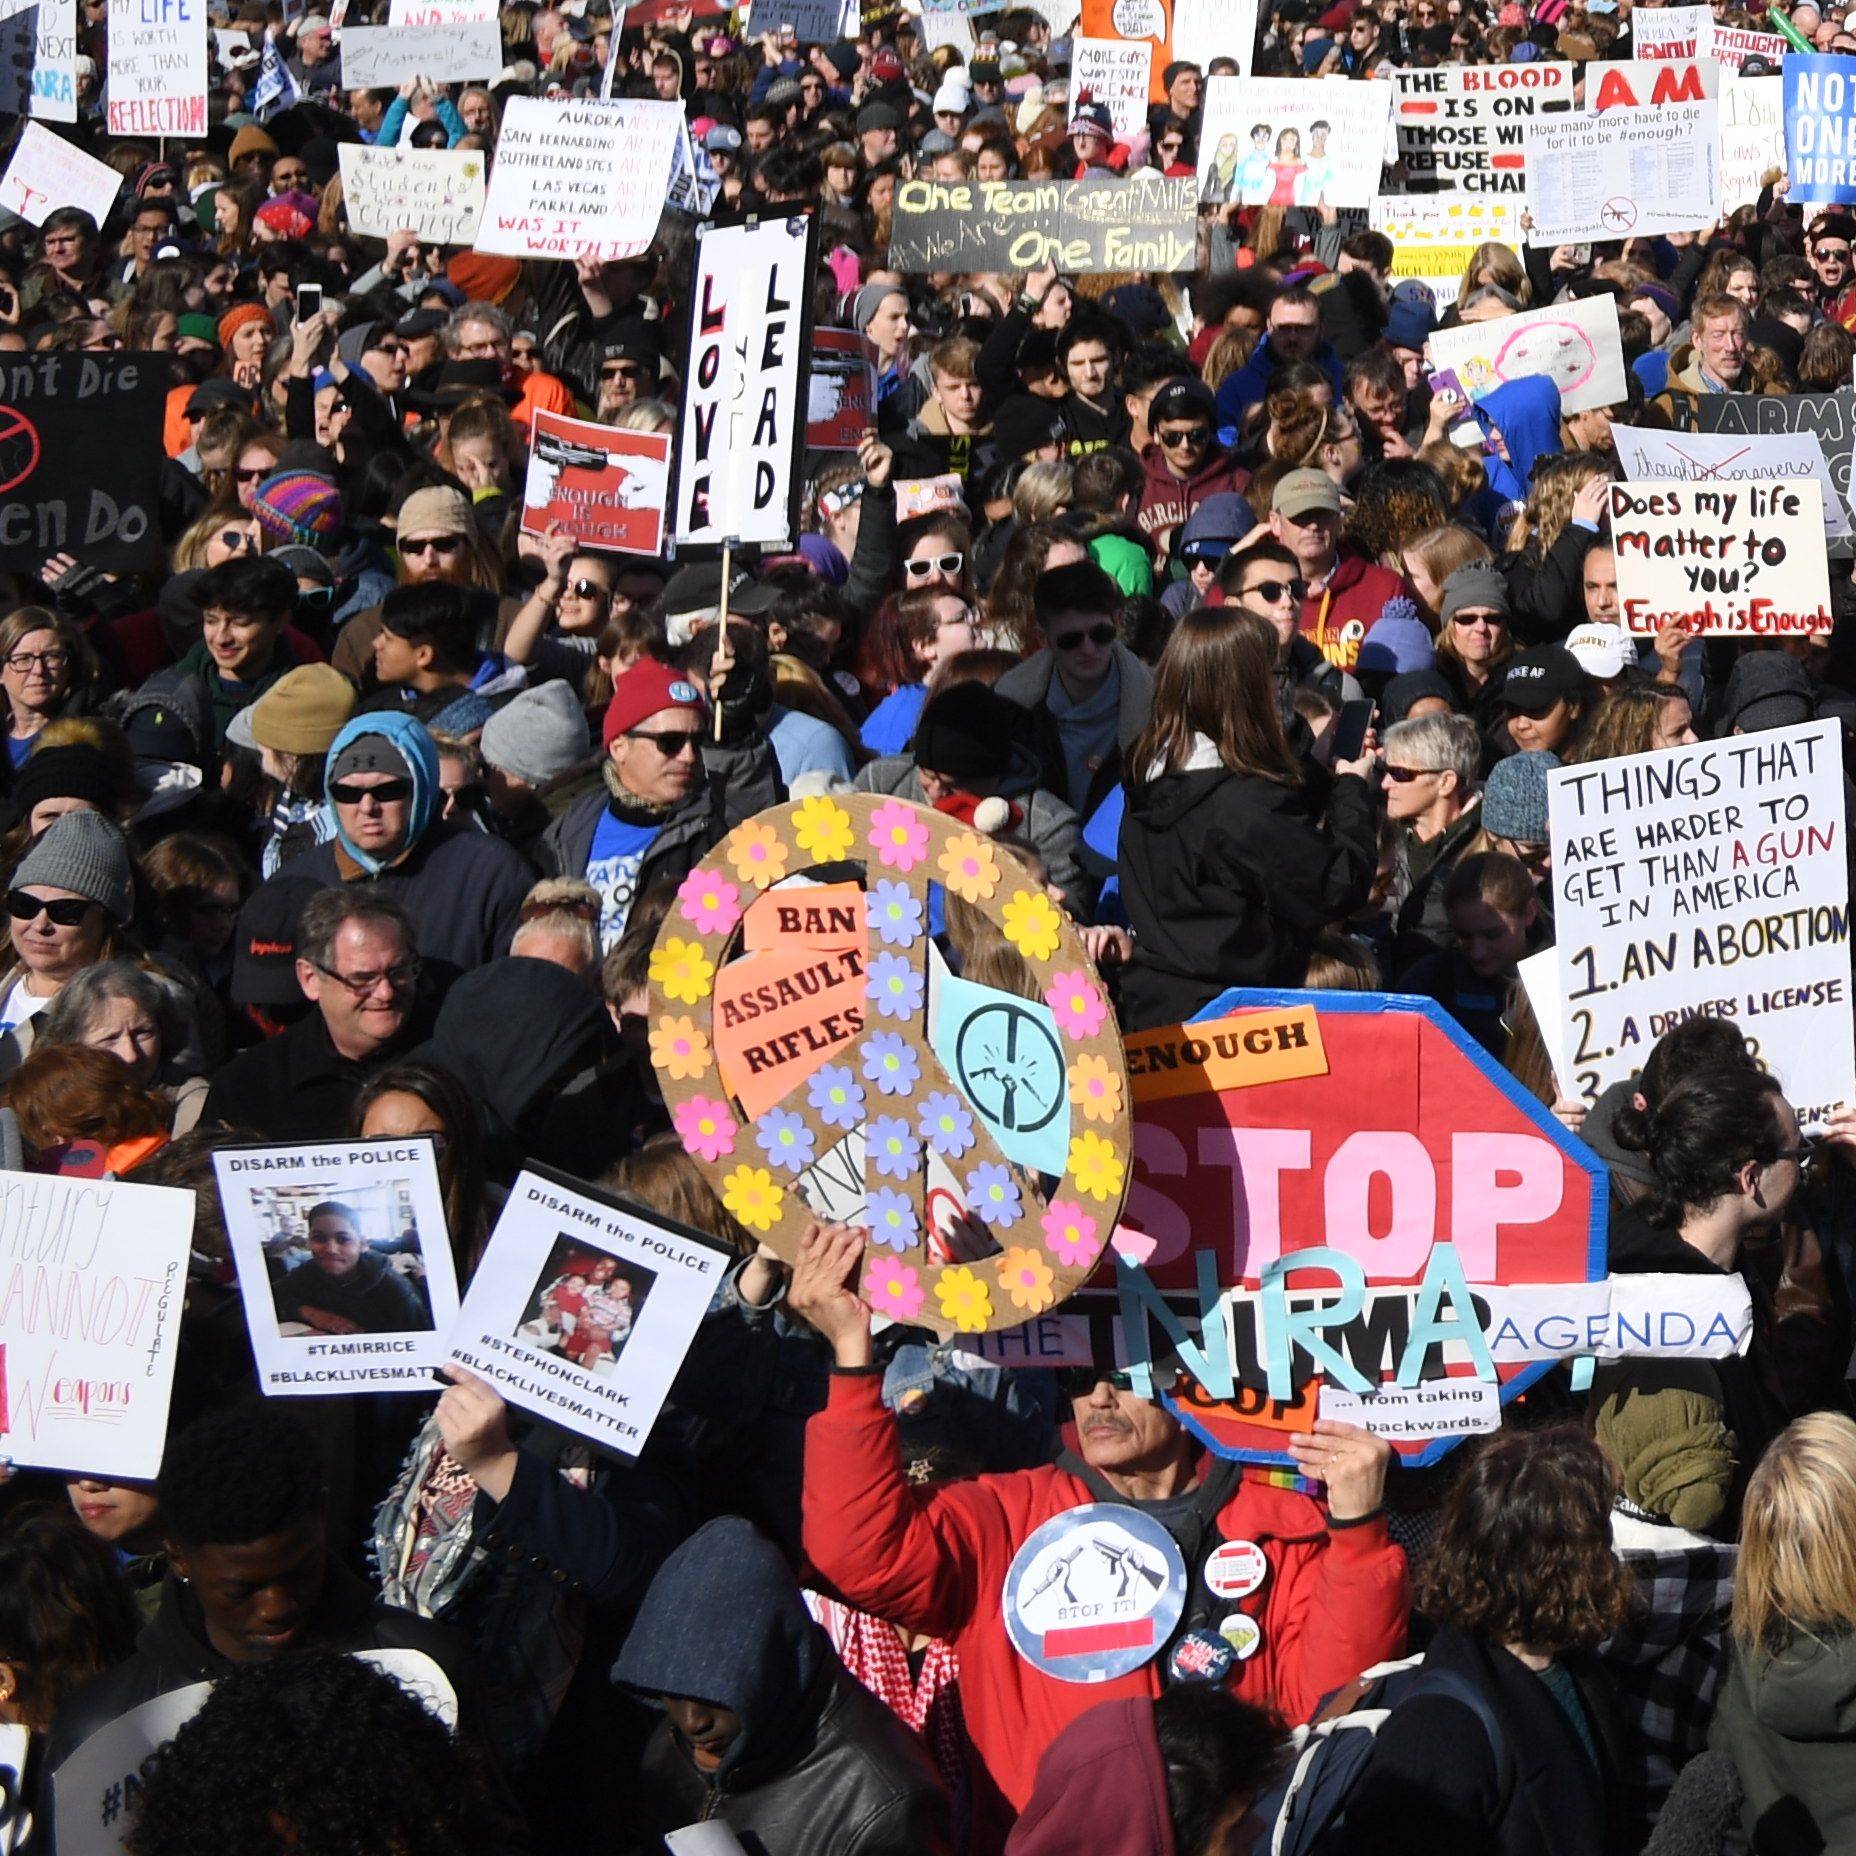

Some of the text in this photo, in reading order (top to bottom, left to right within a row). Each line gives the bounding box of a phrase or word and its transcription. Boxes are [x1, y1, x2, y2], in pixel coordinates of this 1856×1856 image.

[1396, 68, 1561, 93] THE BLOOD
[559, 111, 625, 129] AURORA
[1445, 97, 1534, 117] IS ON
[1530, 111, 1662, 137] How have
[1405, 126, 1487, 145] THOSE
[1402, 152, 1490, 170] REFUSE
[529, 200, 608, 215] PARKLAND
[899, 181, 1059, 215] One Team
[1009, 227, 1195, 272] One Family
[78, 357, 138, 398] Die
[752, 262, 790, 509] LEAD
[84, 489, 148, 544] Do
[1612, 485, 1800, 525] Does my life
[1743, 529, 1786, 566] to
[1684, 561, 1760, 594] you?
[1728, 601, 1747, 631] is
[1560, 735, 1824, 816] THINGS THAT
[1564, 794, 1809, 866] ARE HARDER TO
[1564, 821, 1834, 907] GET THAN A GUN
[1600, 865, 1800, 928] IN AMERICA
[777, 906, 857, 934] BAN
[1621, 904, 1849, 984] AN ABORTION
[720, 949, 864, 1028] ASSAULT
[1620, 979, 1843, 1046] A LICENSE
[742, 1006, 864, 1074] RIFLES
[1125, 1021, 1310, 1075] ENOUGH
[230, 1148, 420, 1173] DISARM the POLICE
[1114, 1123, 1564, 1283] STOP
[527, 1188, 712, 1275] DISARM the POLICE
[307, 1340, 416, 1356] #TAMIRRICE
[1491, 1310, 1739, 1352] AGENDA
[480, 1335, 631, 1408] #STEPHONCLARK
[450, 1349, 640, 1441] #BLACKLIVESMATTER
[1417, 1389, 1484, 1406] taking
[1366, 1416, 1489, 1434] backwards.
[1057, 1605, 1104, 1620] STOP
